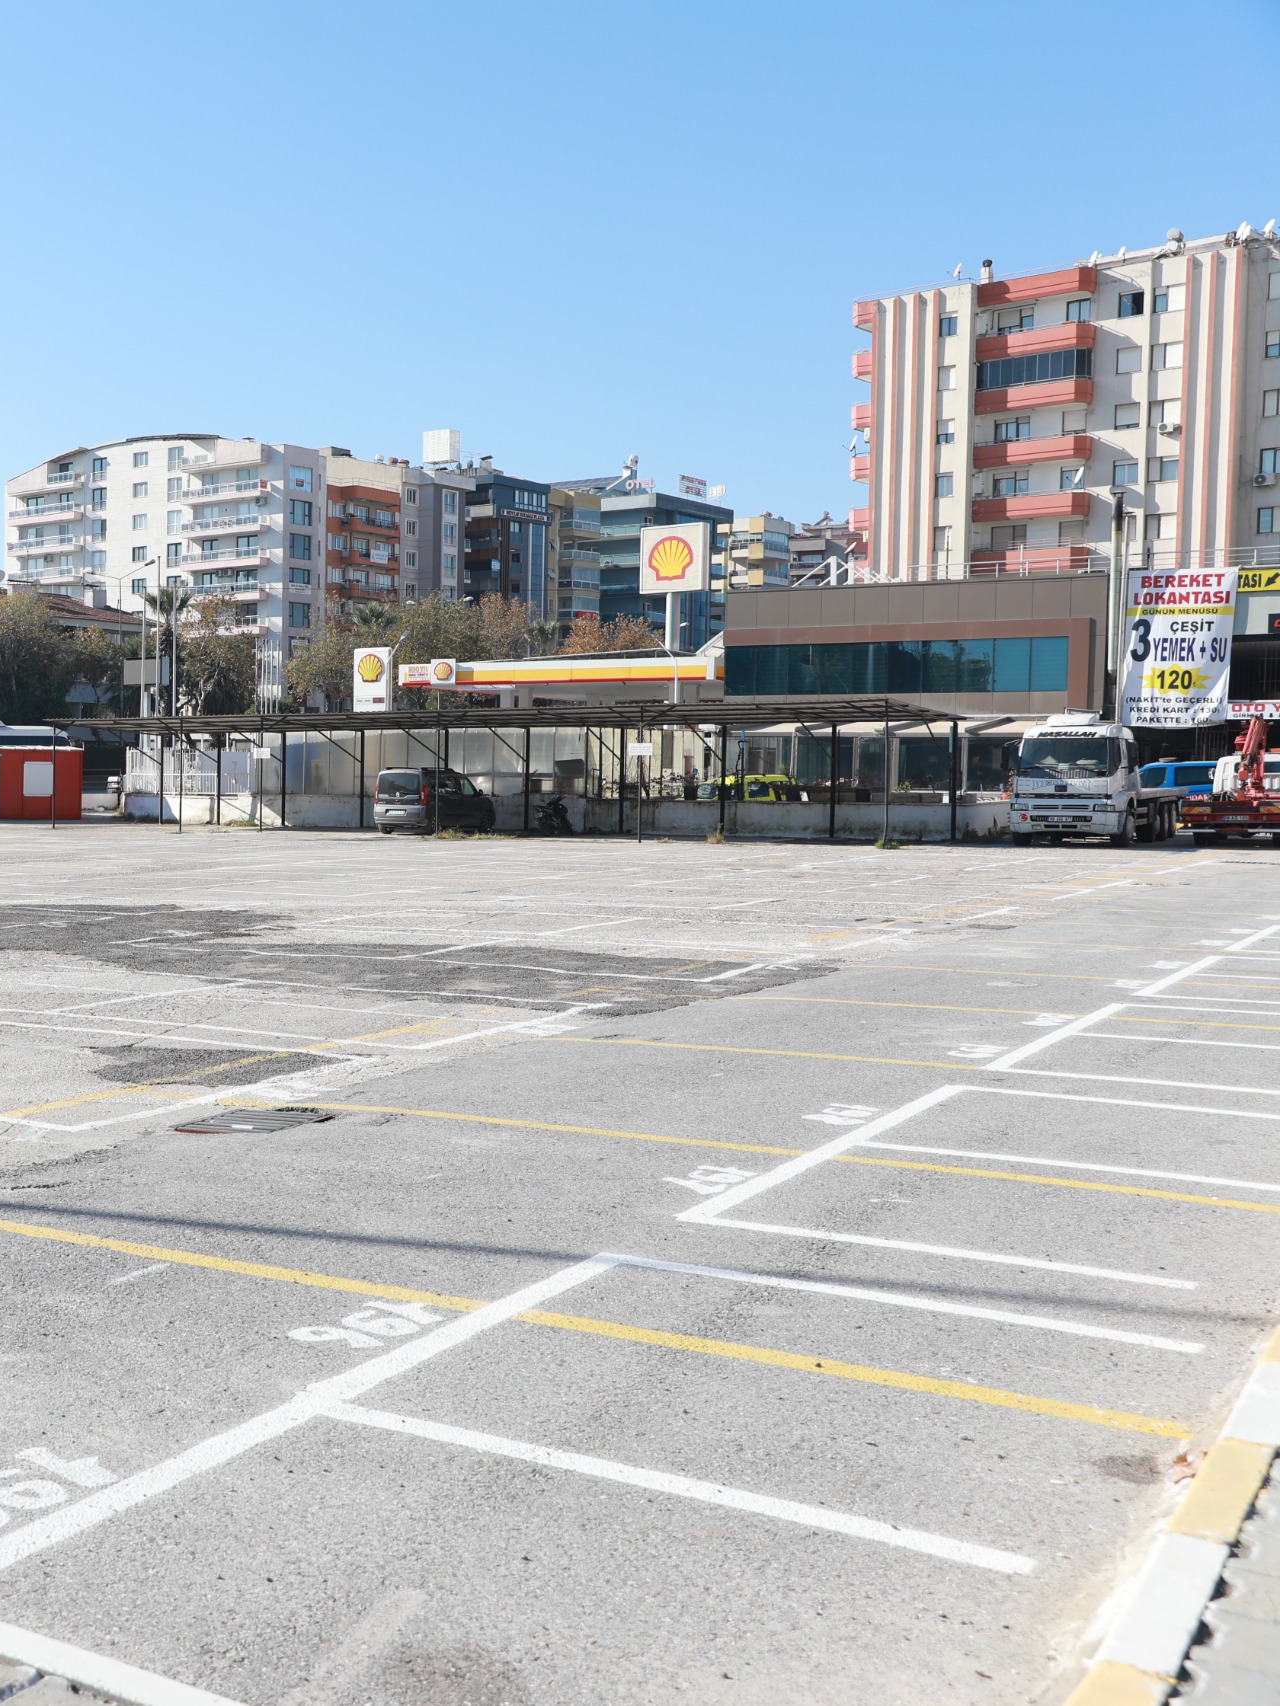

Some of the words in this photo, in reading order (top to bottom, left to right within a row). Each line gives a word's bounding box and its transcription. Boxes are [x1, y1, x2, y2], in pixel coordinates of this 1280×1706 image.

[1141, 573, 1225, 589] BEREKET
[1133, 591, 1230, 606] LOKANTASI
[1170, 618, 1214, 635] ÇEŞİT
[1130, 618, 1151, 662] 3
[1153, 637, 1195, 662] YEMEK
[1210, 637, 1228, 662] SU
[1232, 703, 1265, 712] OTO
[802, 1103, 881, 1125] 198
[662, 1165, 758, 1195] 197
[288, 1300, 444, 1348] 196
